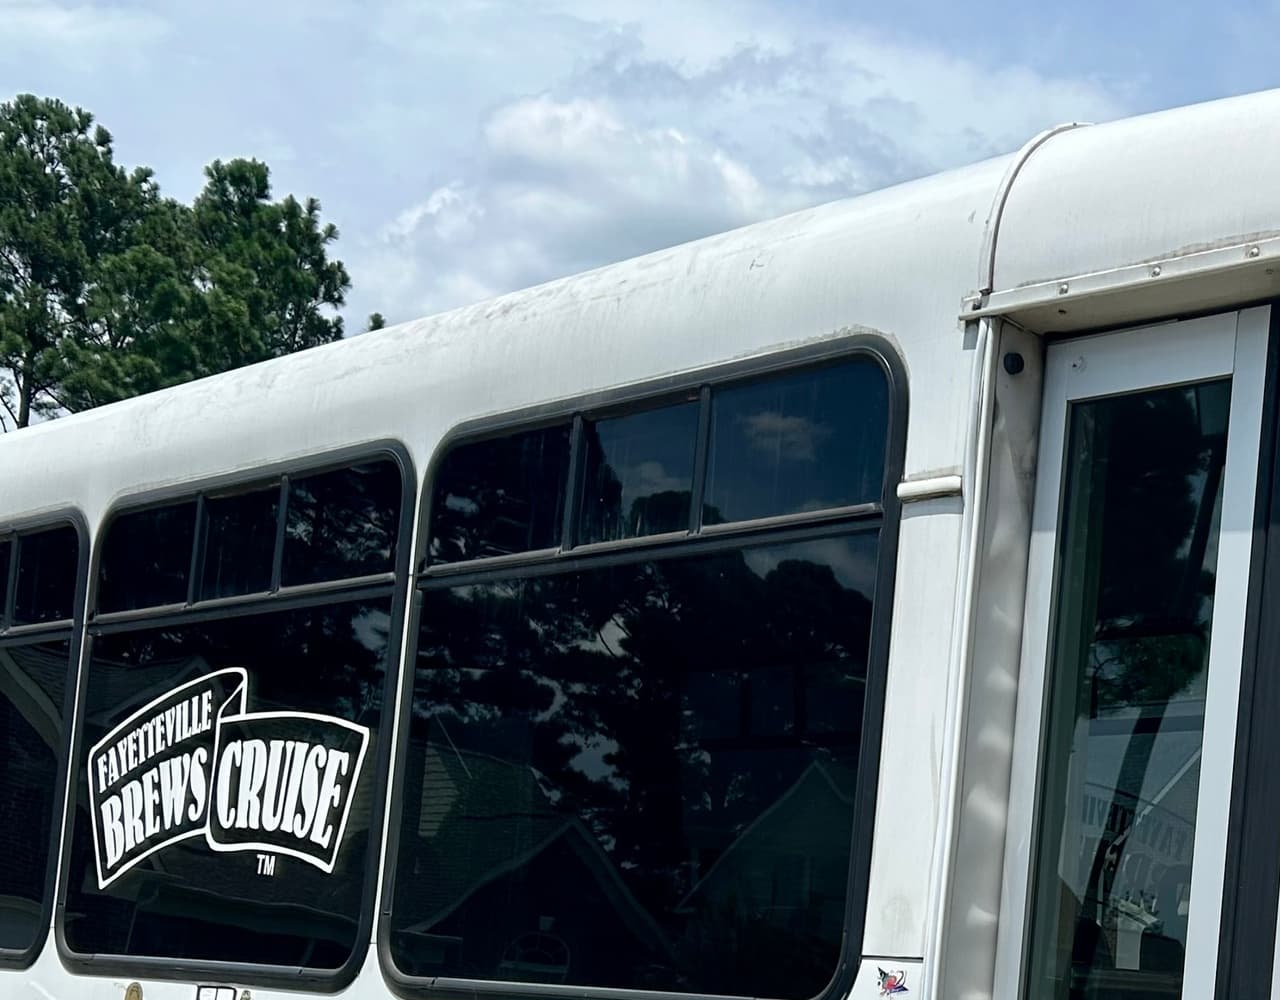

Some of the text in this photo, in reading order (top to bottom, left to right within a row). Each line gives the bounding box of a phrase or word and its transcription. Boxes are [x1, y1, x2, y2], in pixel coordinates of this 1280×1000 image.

[96, 689, 213, 794] FAYETTEVILLE
[100, 738, 350, 870] BREWS CRUISE
[257, 853, 276, 876] TM
